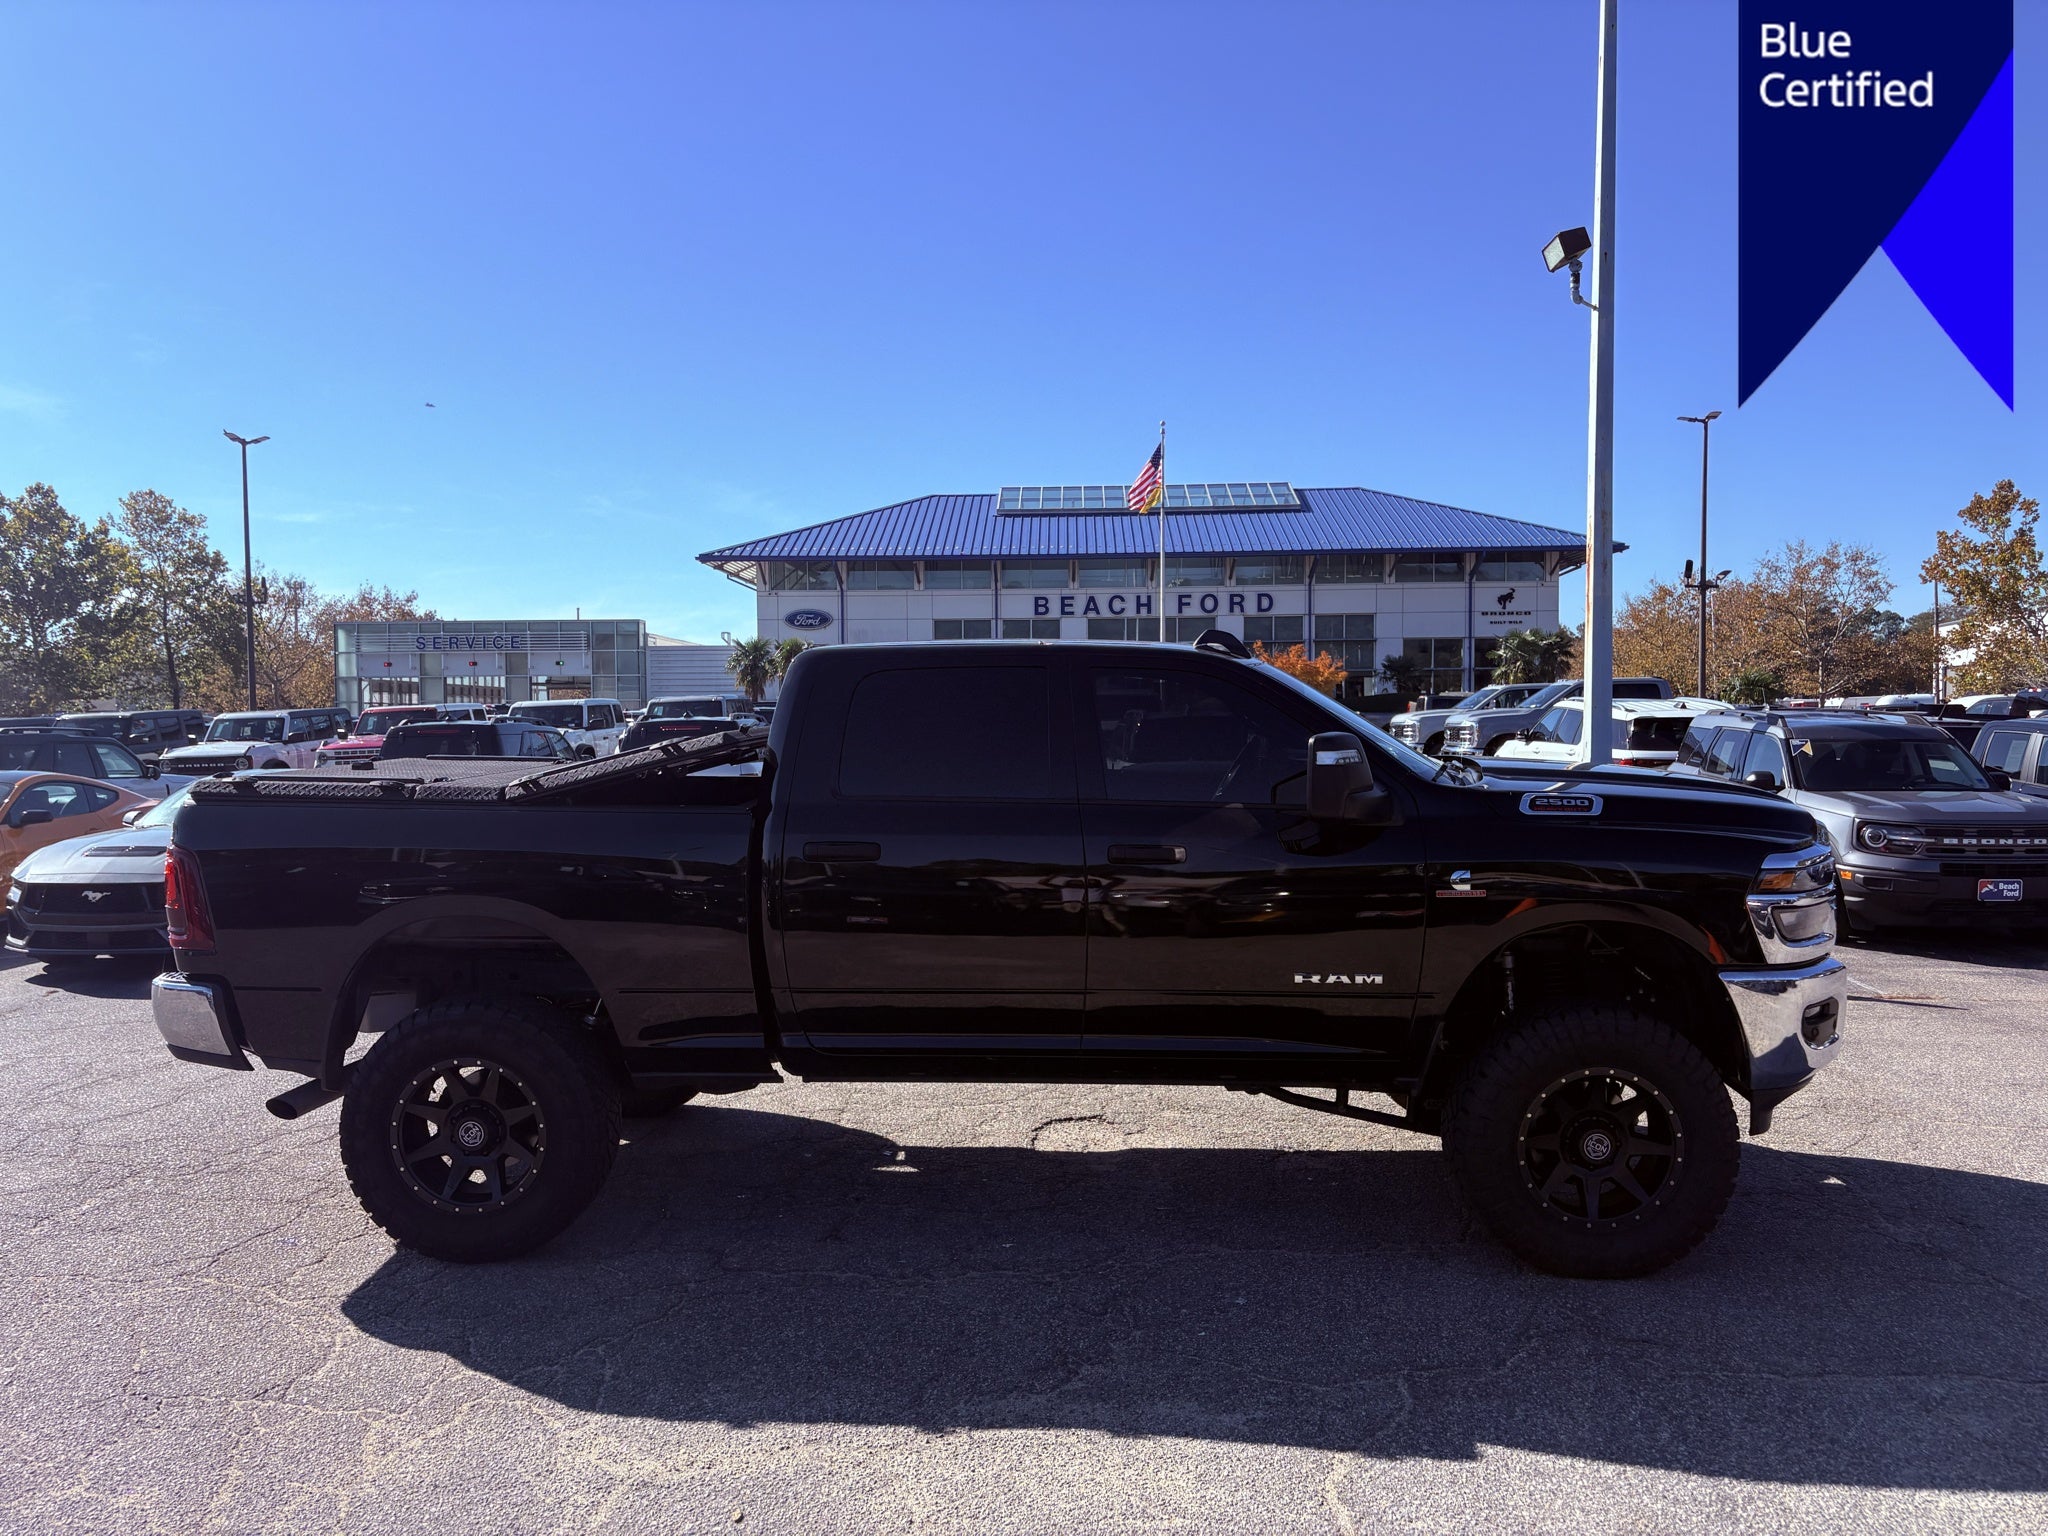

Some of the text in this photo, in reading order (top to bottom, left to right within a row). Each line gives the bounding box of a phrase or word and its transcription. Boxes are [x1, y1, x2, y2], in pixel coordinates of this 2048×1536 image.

[1034, 592, 1274, 616] BEACH FORD
[794, 613, 821, 625] Ford
[415, 635, 521, 650] SERVICE
[1535, 798, 1589, 806] 2500
[1998, 882, 2020, 890] Beach
[2003, 889, 2020, 897] Ford
[1294, 973, 1384, 985] RAM
[1587, 1139, 1608, 1153] ICON
